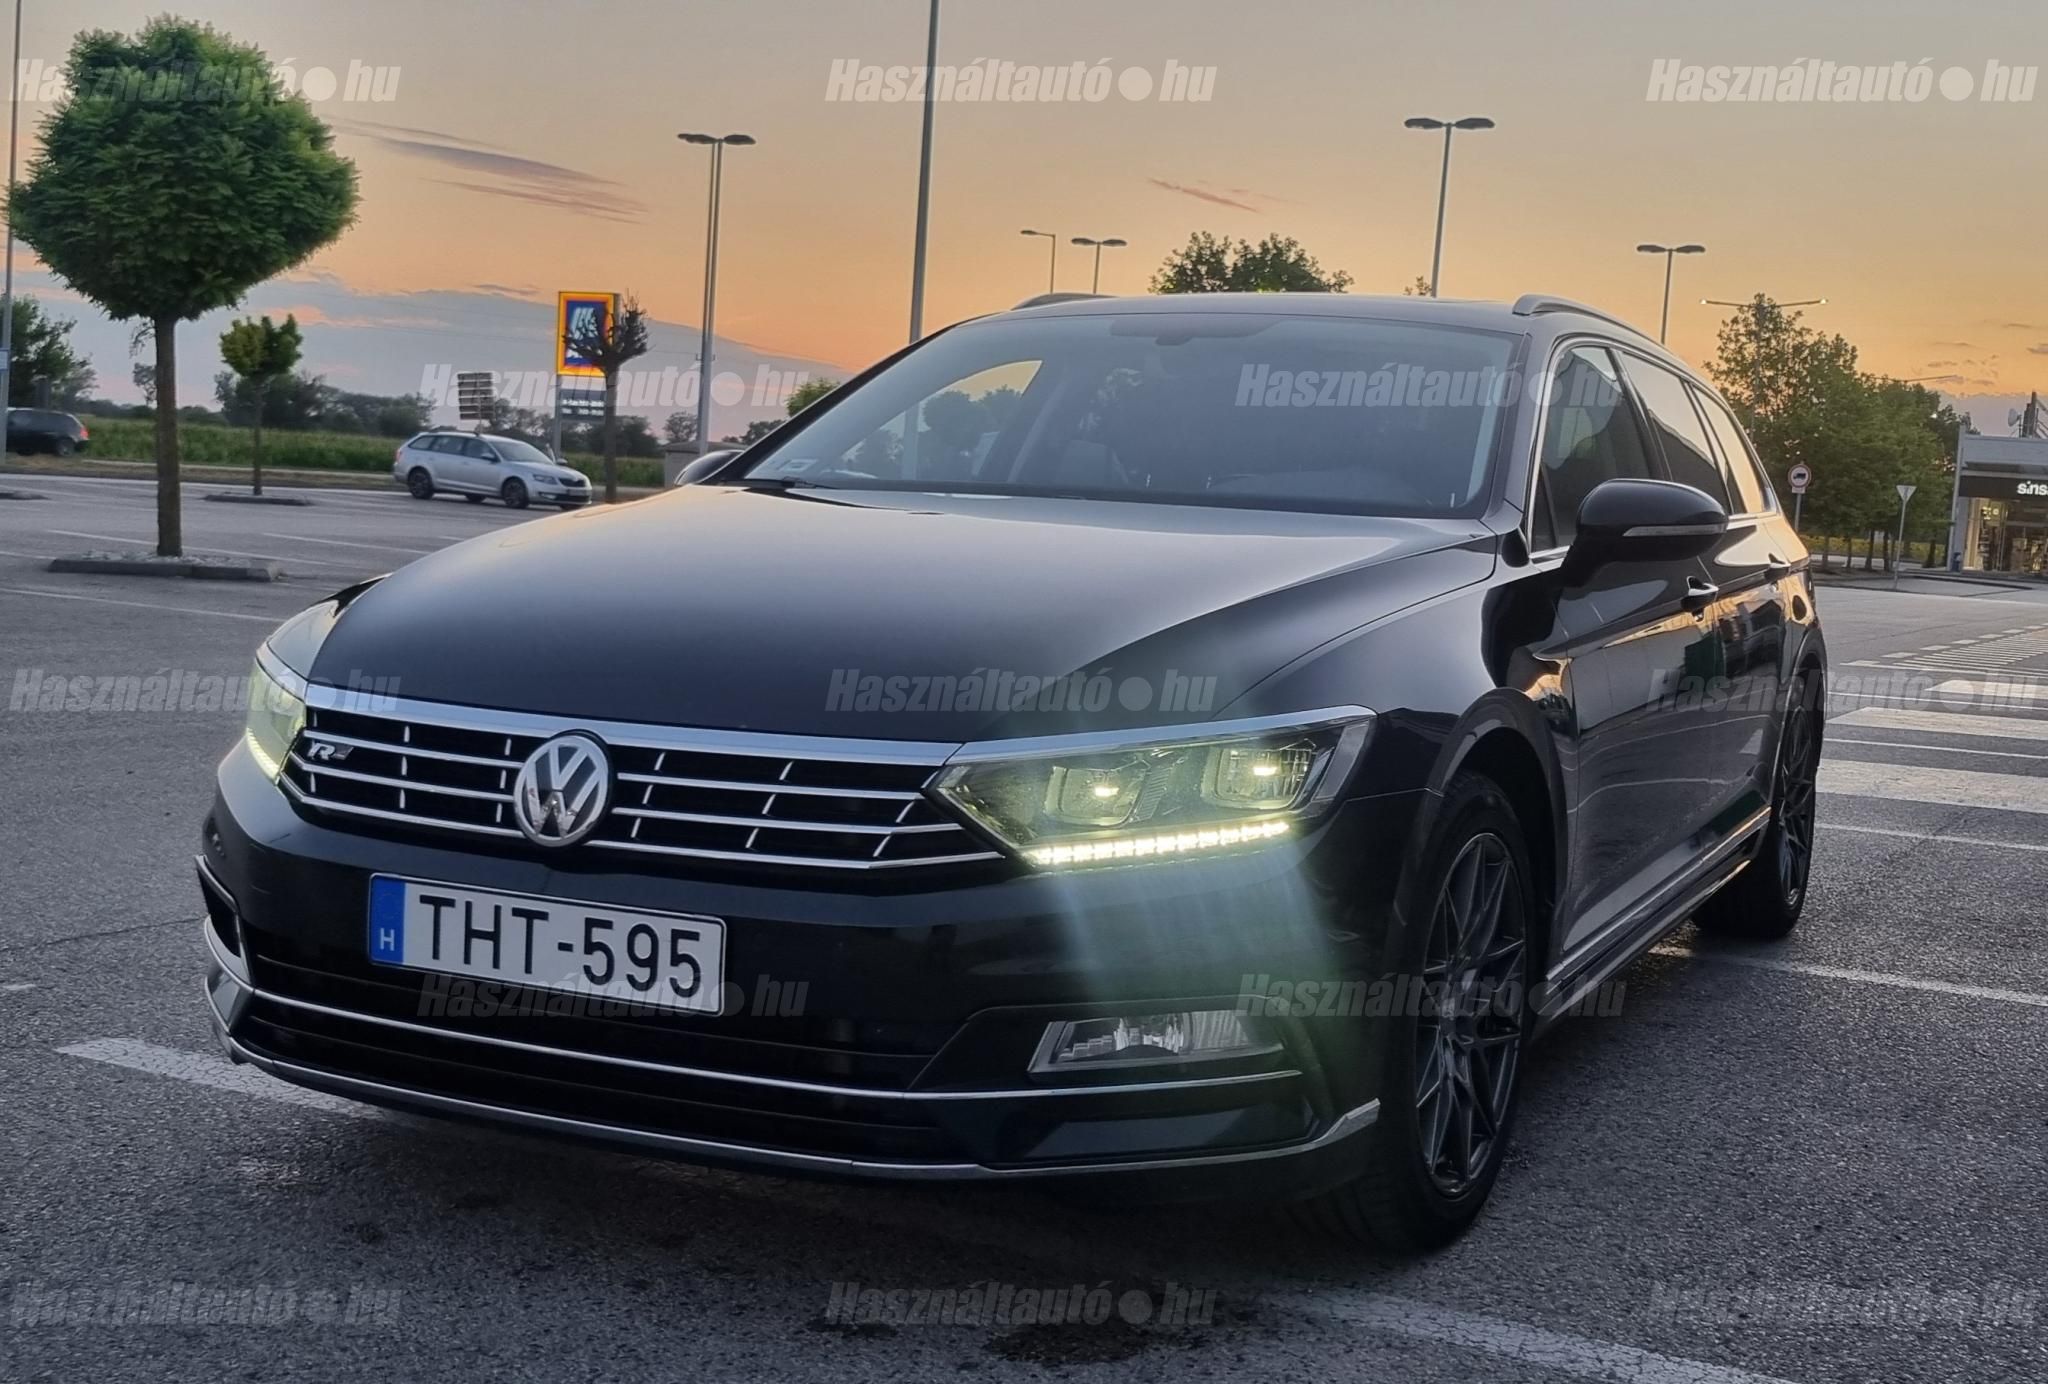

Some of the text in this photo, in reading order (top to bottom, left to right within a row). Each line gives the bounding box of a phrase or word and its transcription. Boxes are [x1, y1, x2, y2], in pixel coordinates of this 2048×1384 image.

[2017, 480, 2048, 496] sins
[378, 894, 701, 999] H THT-595
